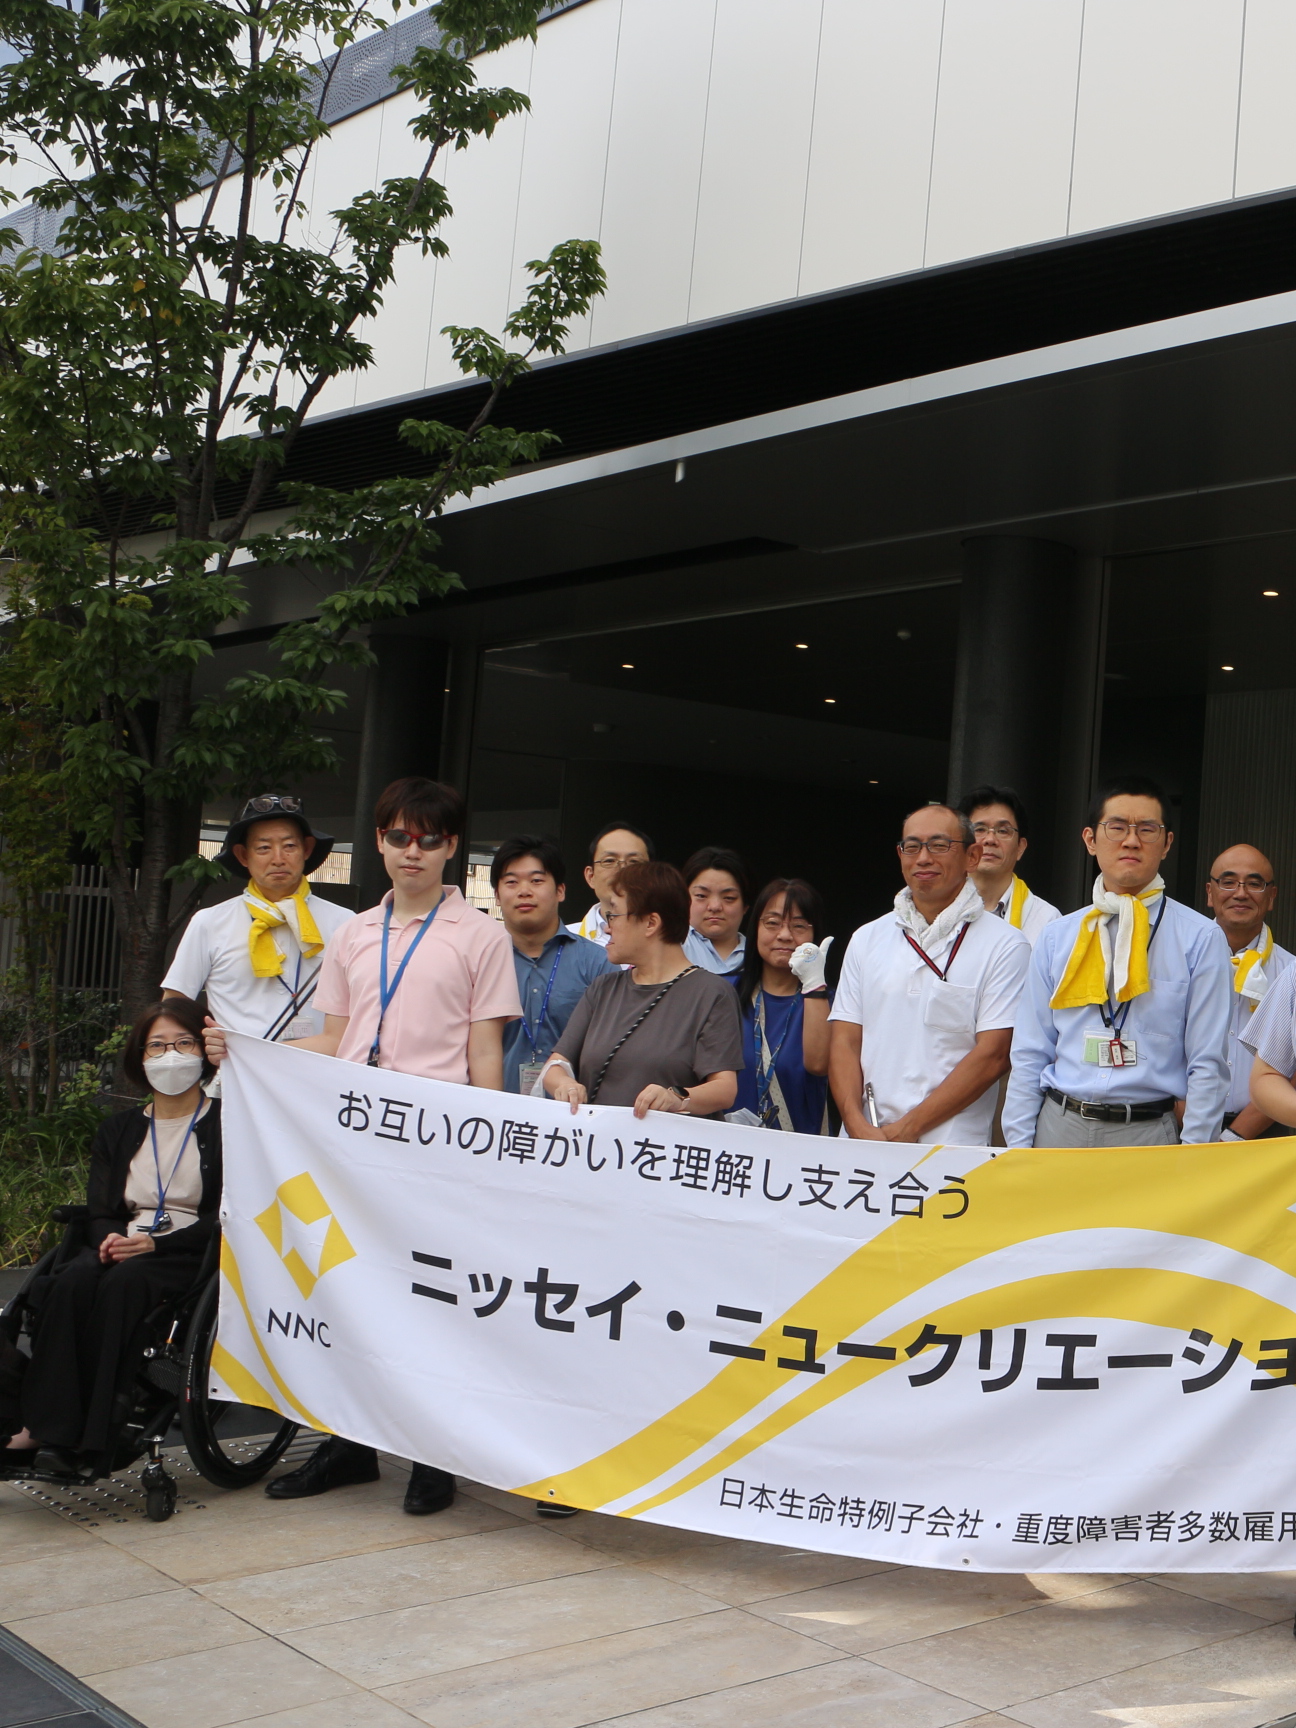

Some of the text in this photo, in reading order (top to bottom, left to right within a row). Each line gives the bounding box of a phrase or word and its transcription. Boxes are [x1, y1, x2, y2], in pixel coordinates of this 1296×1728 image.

[337, 1090, 970, 1220] お互いの障がいを理解し支え合う
[267, 1308, 332, 1348] NNC
